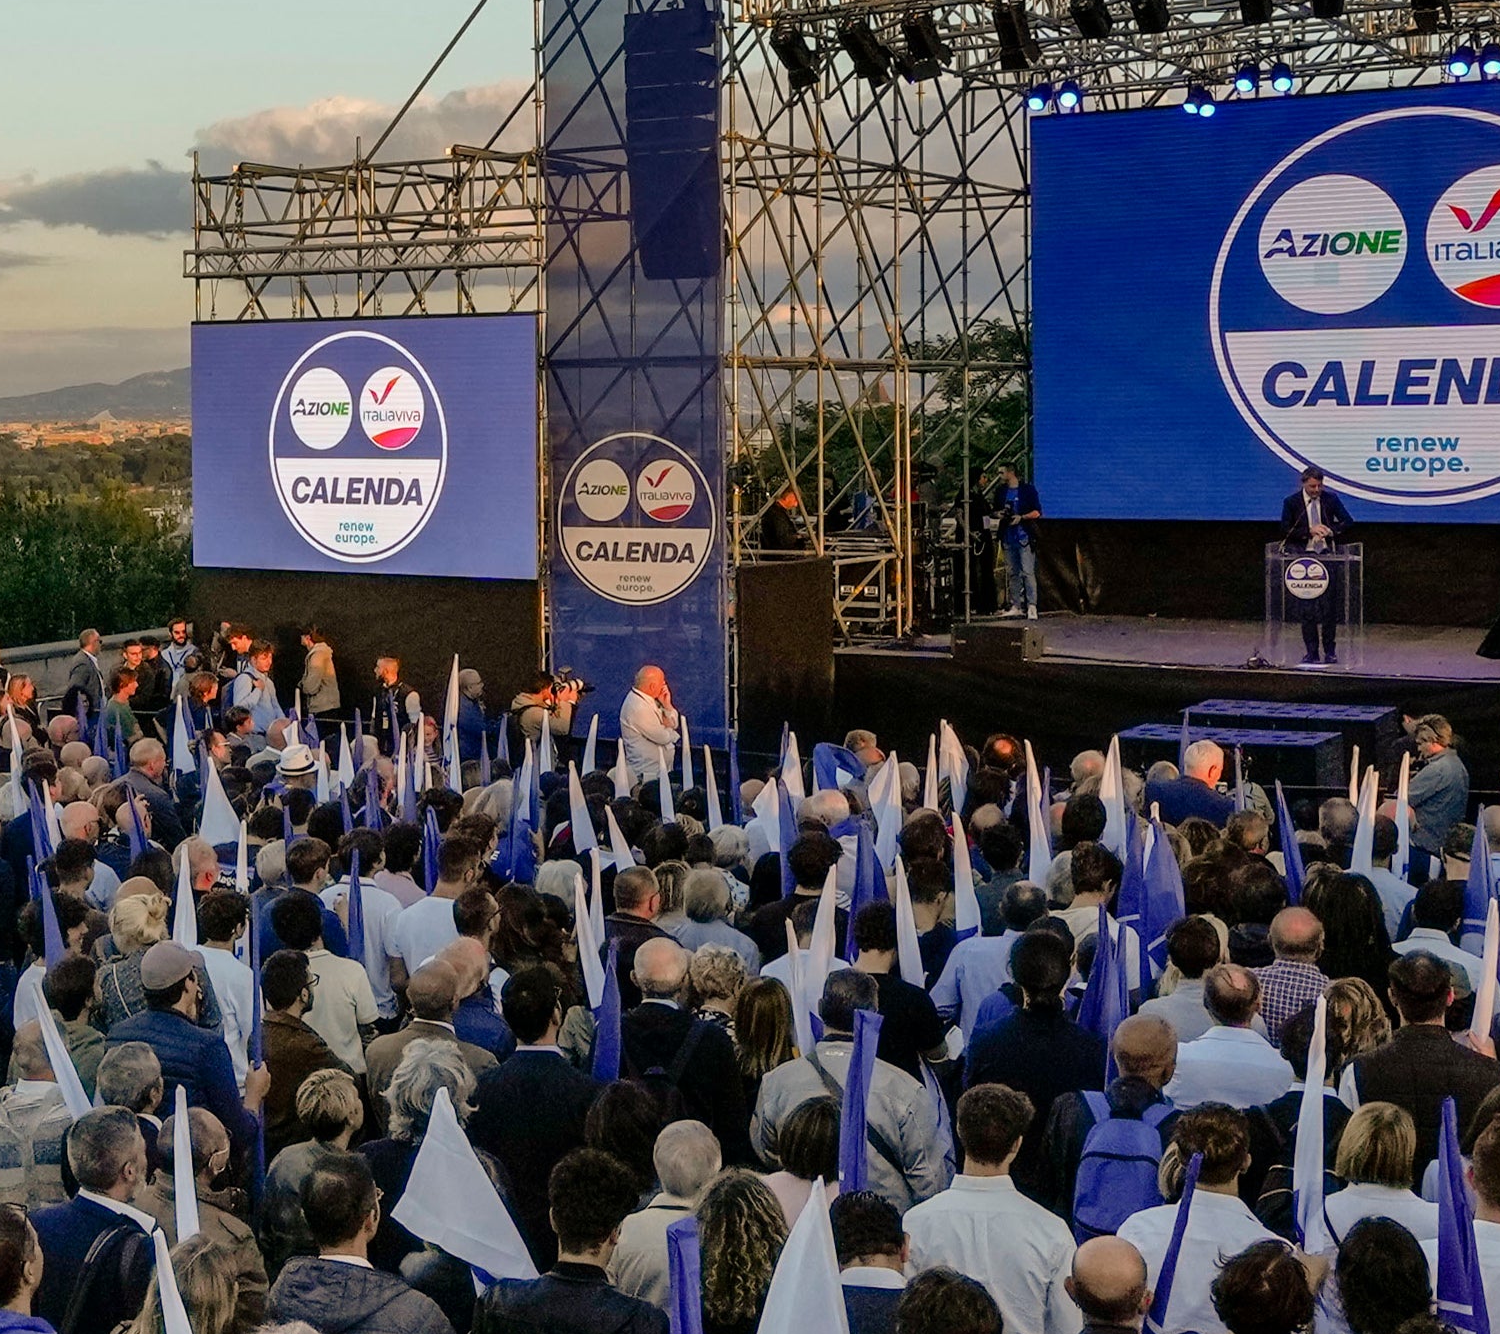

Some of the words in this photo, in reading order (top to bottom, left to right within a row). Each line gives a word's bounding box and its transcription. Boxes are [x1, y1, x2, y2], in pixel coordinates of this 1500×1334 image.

[1263, 228, 1402, 259] AZIONE
[292, 398, 350, 417] AZIONE
[1375, 434, 1460, 453] renew
[1365, 454, 1470, 477] europe.
[291, 476, 423, 506] CALENDA
[578, 482, 627, 496] AZIONE
[339, 522, 374, 532] renew
[335, 533, 378, 546] europe.
[576, 540, 694, 564] CALENDA
[619, 574, 651, 583] renew
[616, 584, 655, 594] europe.
